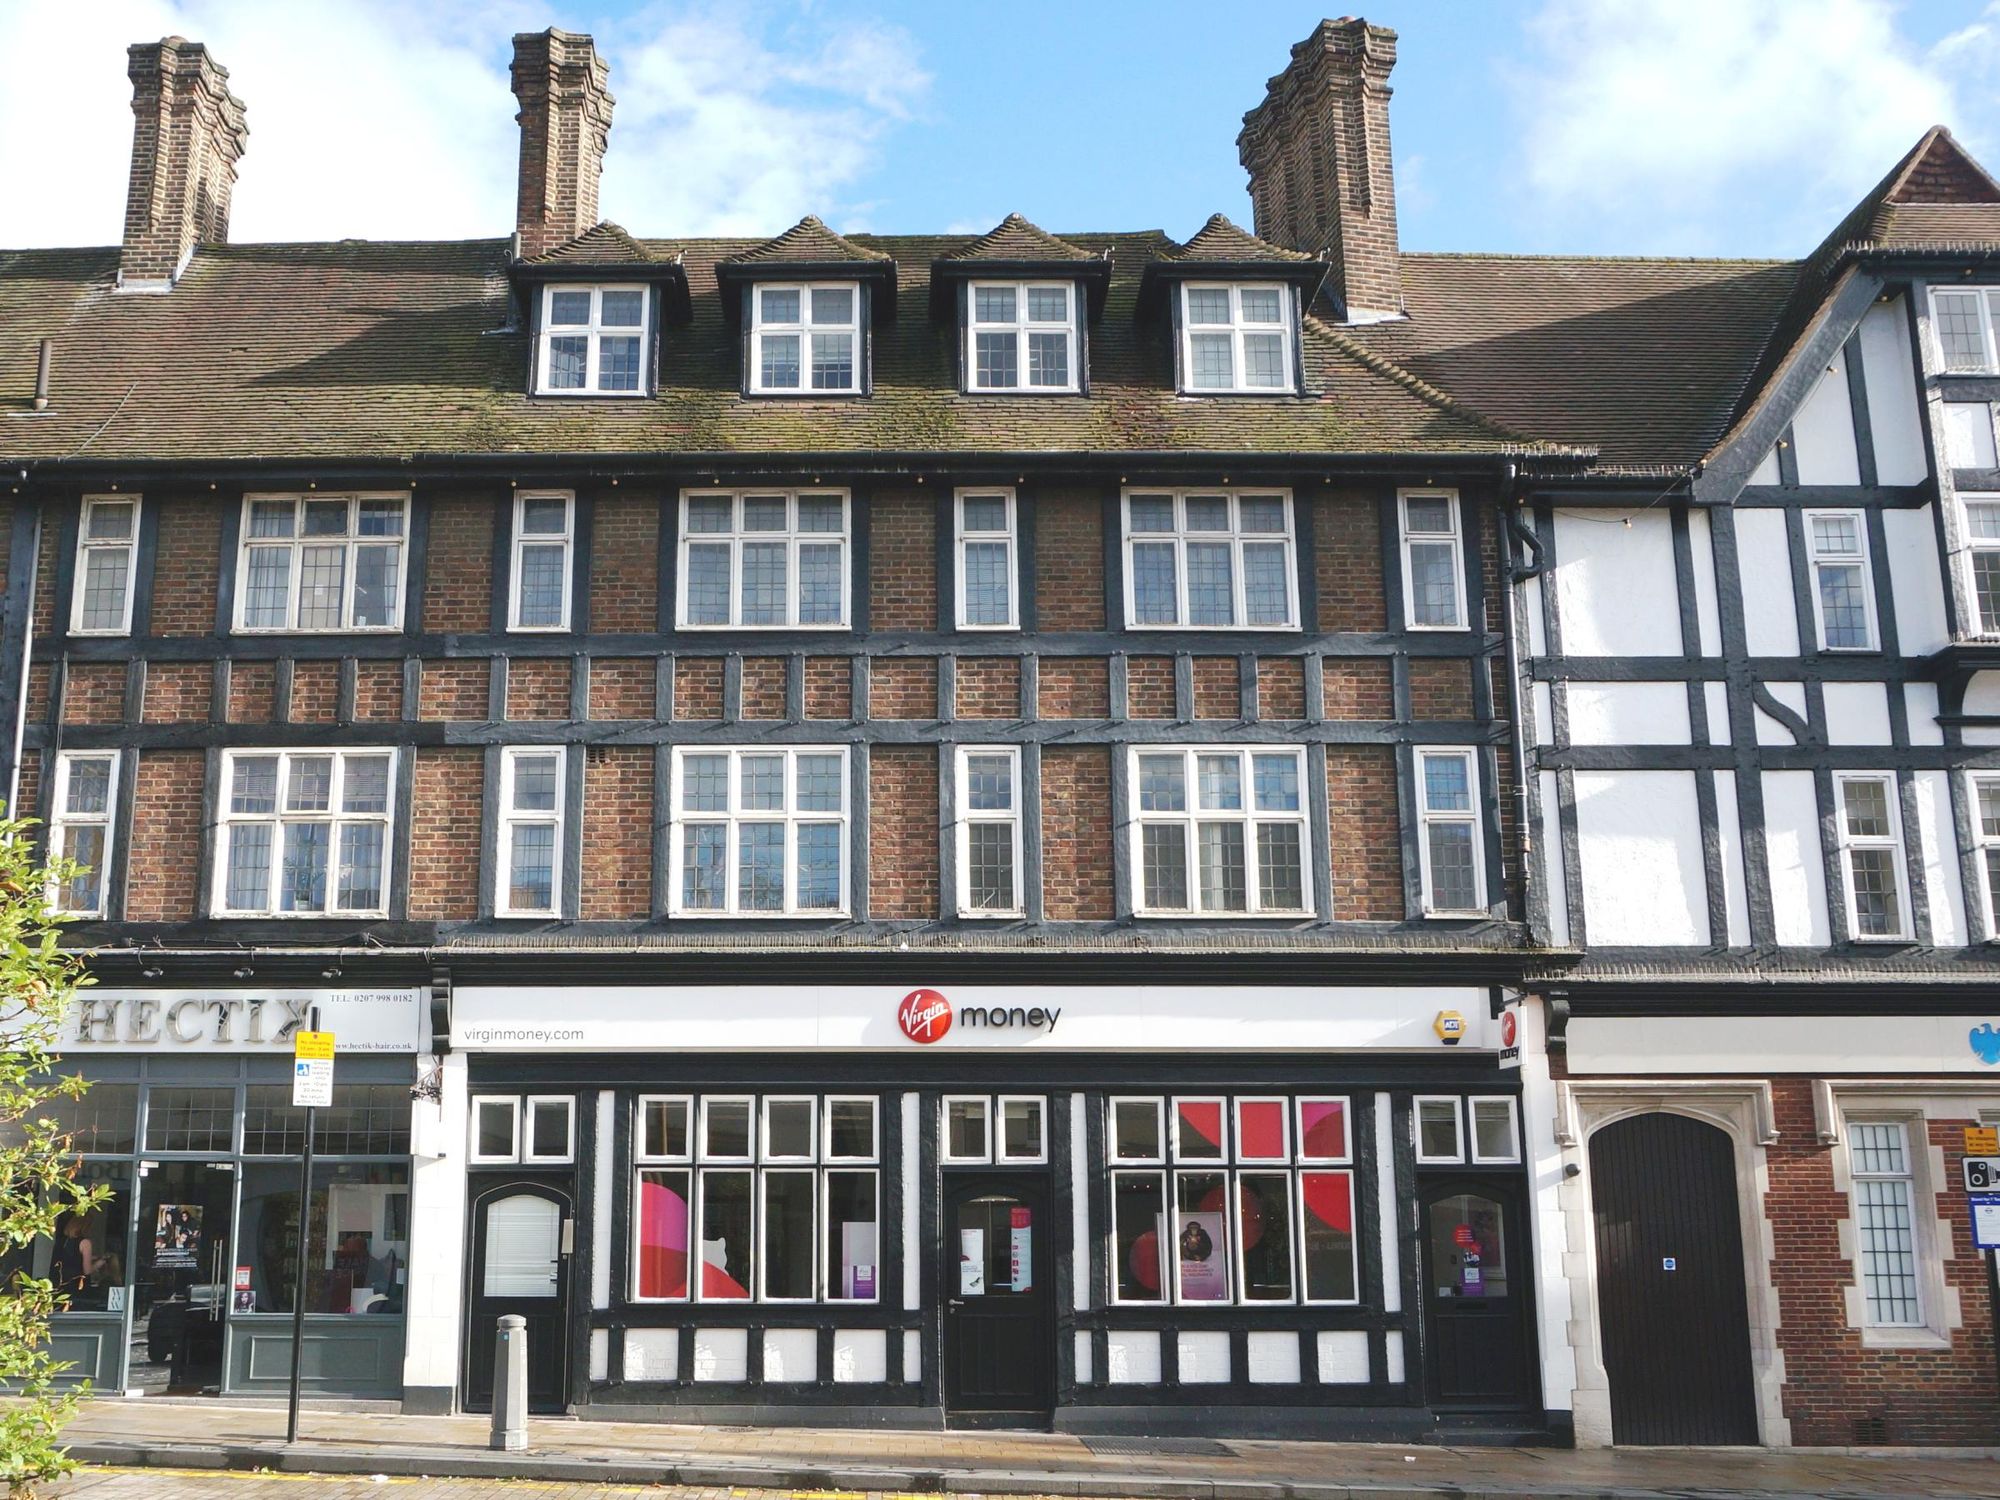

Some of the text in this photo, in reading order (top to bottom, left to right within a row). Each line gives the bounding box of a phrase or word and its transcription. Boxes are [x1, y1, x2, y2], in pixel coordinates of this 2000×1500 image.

[354, 994, 374, 1002] 0207
[376, 994, 391, 1002] 998
[393, 994, 413, 1002] 0182
[901, 993, 1062, 1037] Virgin money
[464, 1027, 584, 1044] virginmoney.com
